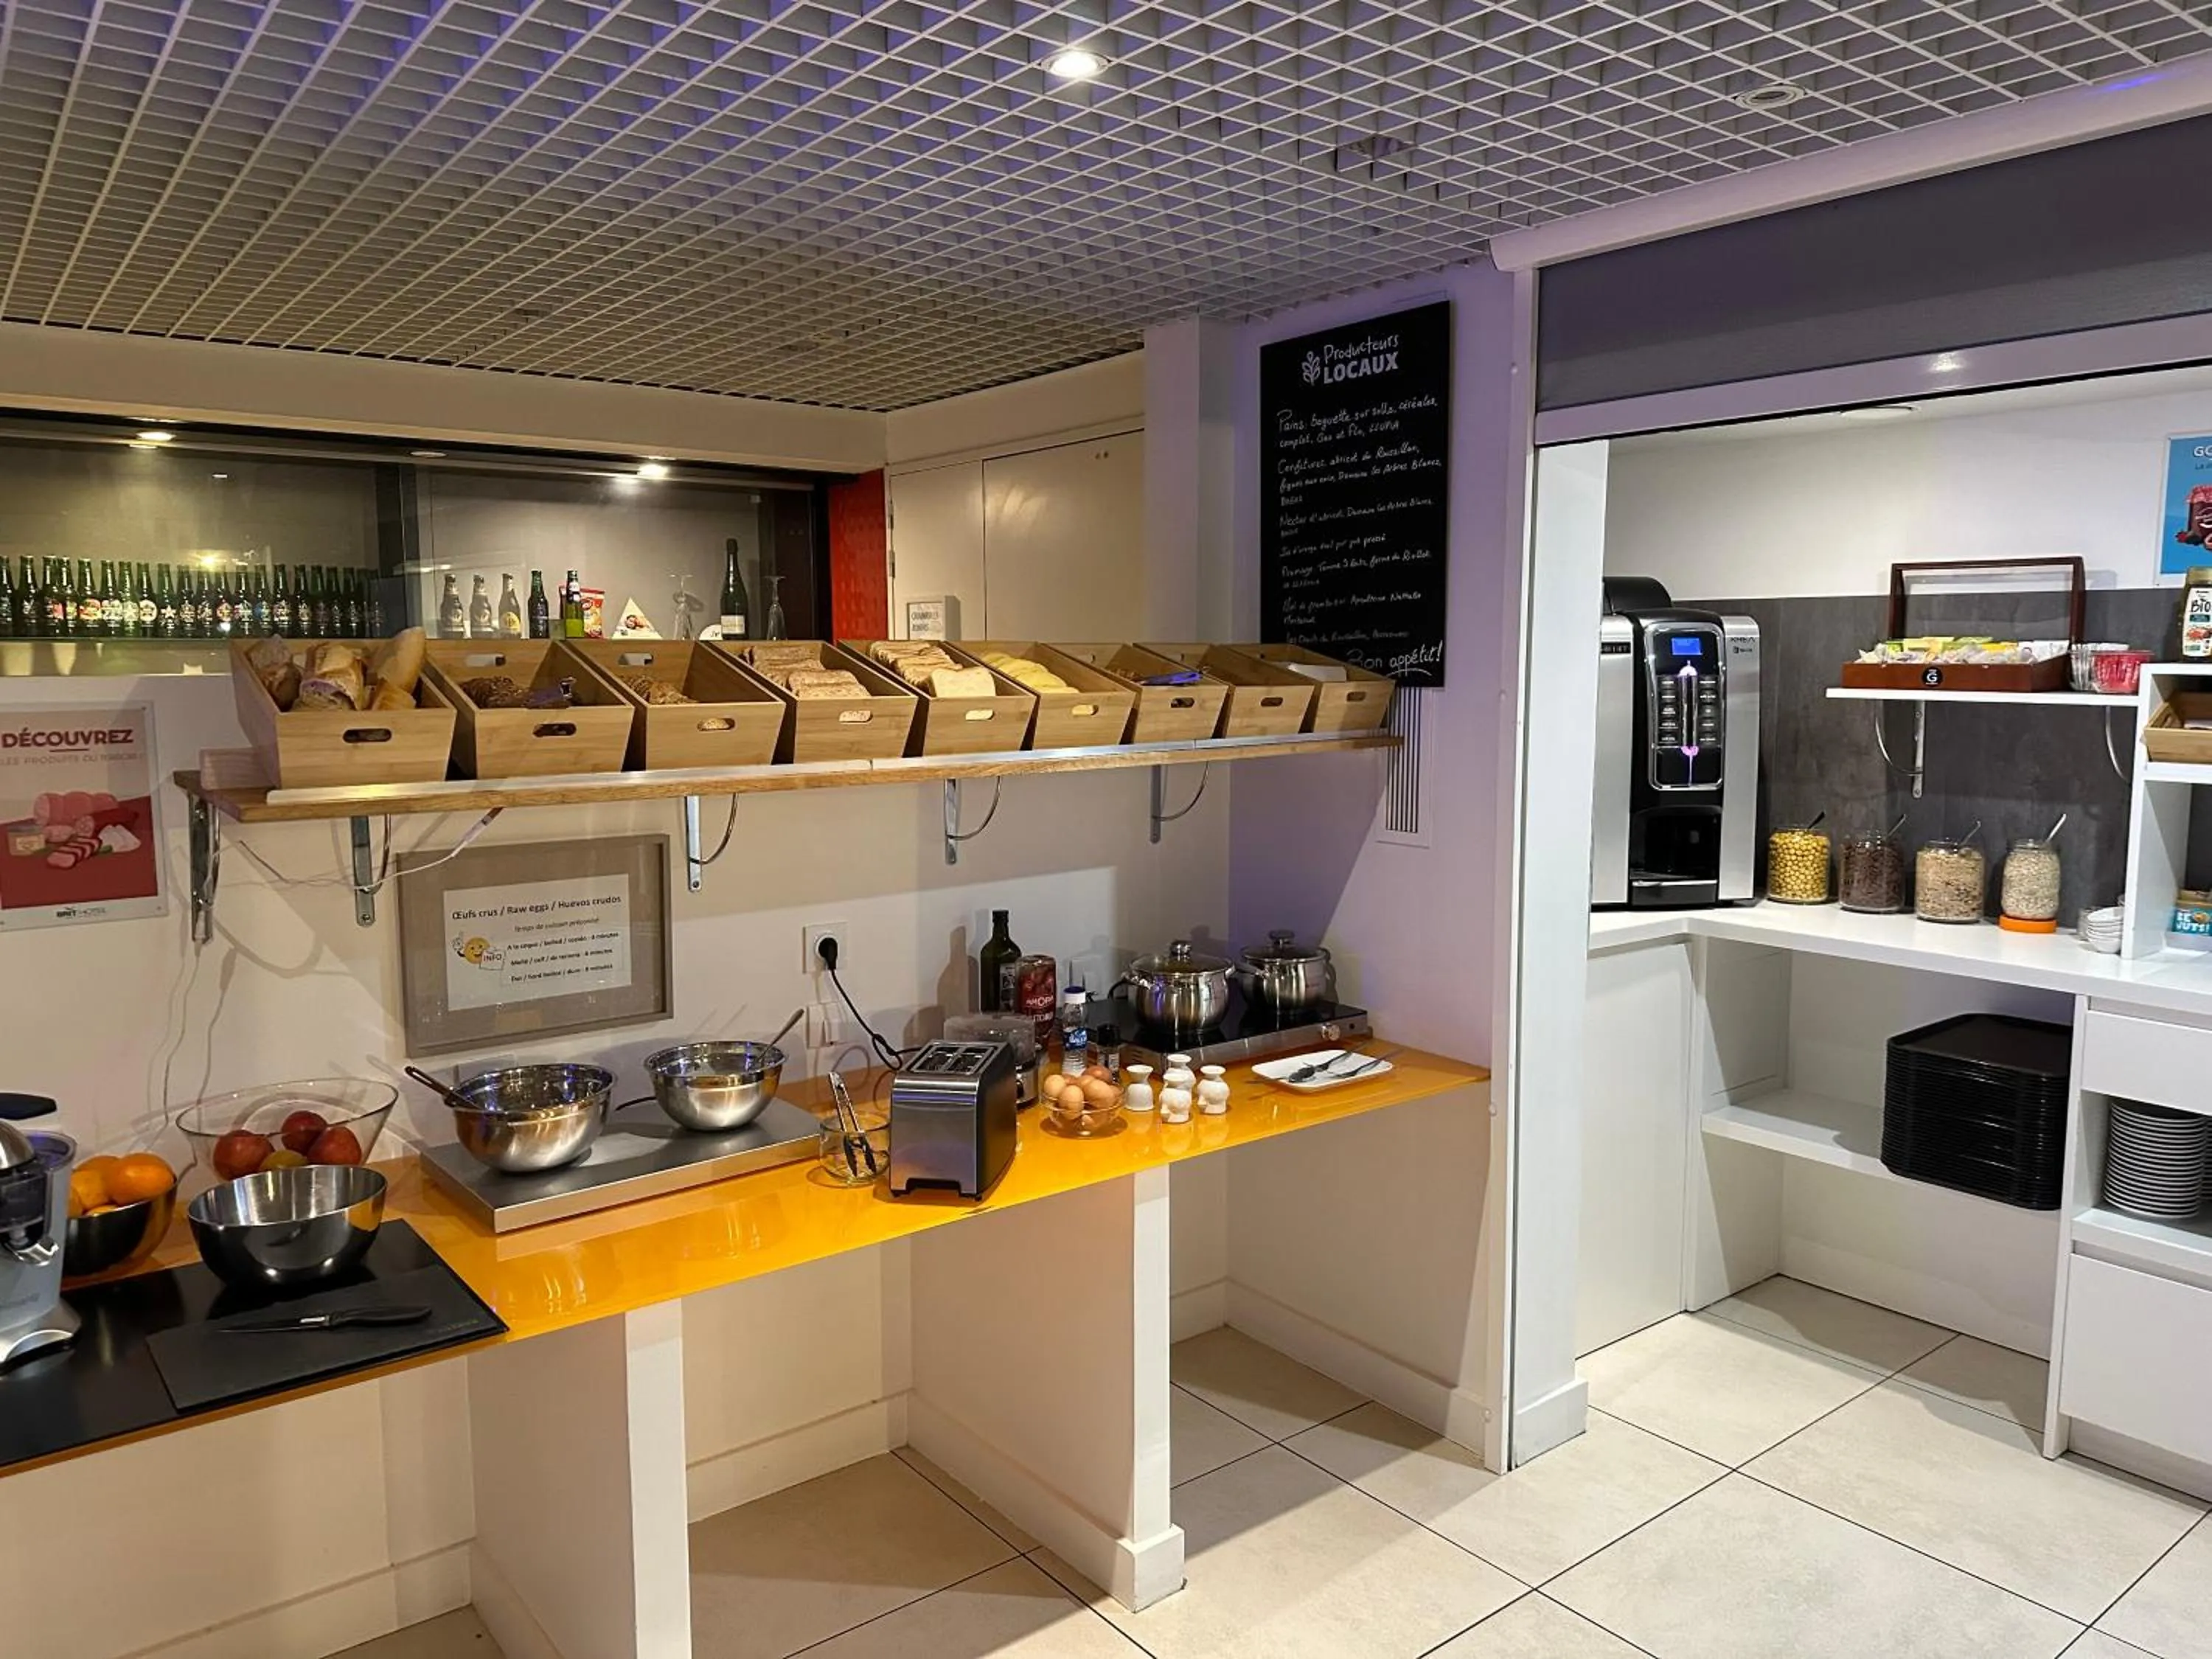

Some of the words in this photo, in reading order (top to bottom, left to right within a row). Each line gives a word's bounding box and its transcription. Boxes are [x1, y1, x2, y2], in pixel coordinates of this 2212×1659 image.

[1324, 335, 1399, 364] Producteurs
[1324, 351, 1399, 384] LOCAUX
[1346, 648, 1382, 669] Bon
[1389, 639, 1443, 677] appétit!
[1, 727, 134, 748] DÉCOUVREZ
[452, 910, 477, 920] Œufs
[479, 908, 498, 918] crus
[507, 905, 527, 915] Raw
[529, 903, 549, 914] eggs
[558, 898, 591, 909] Huevos
[592, 896, 622, 905] crudos
